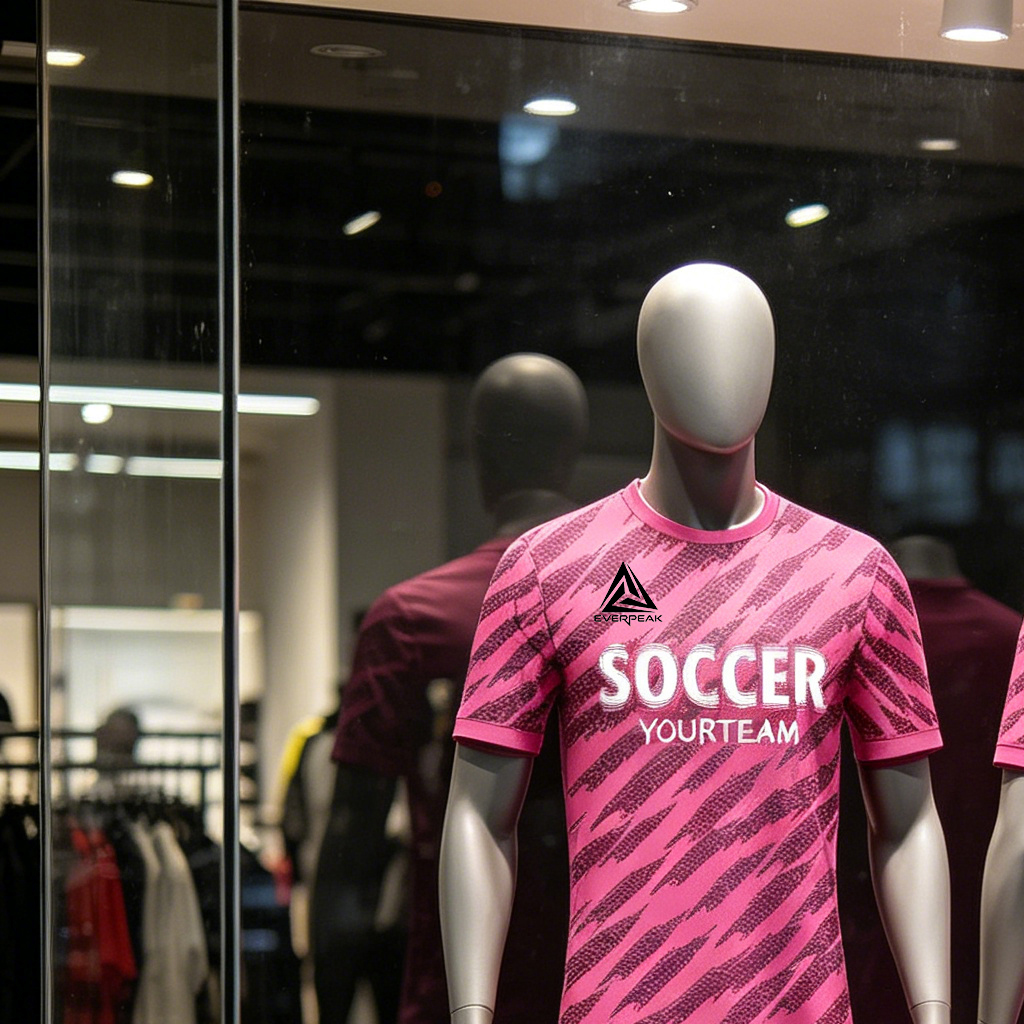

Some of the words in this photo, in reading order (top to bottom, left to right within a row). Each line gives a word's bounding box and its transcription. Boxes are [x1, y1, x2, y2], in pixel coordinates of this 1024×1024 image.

[594, 614, 662, 626] EVERPEAK
[600, 644, 827, 712] SOCCER
[639, 718, 800, 745] YOURTEAM
